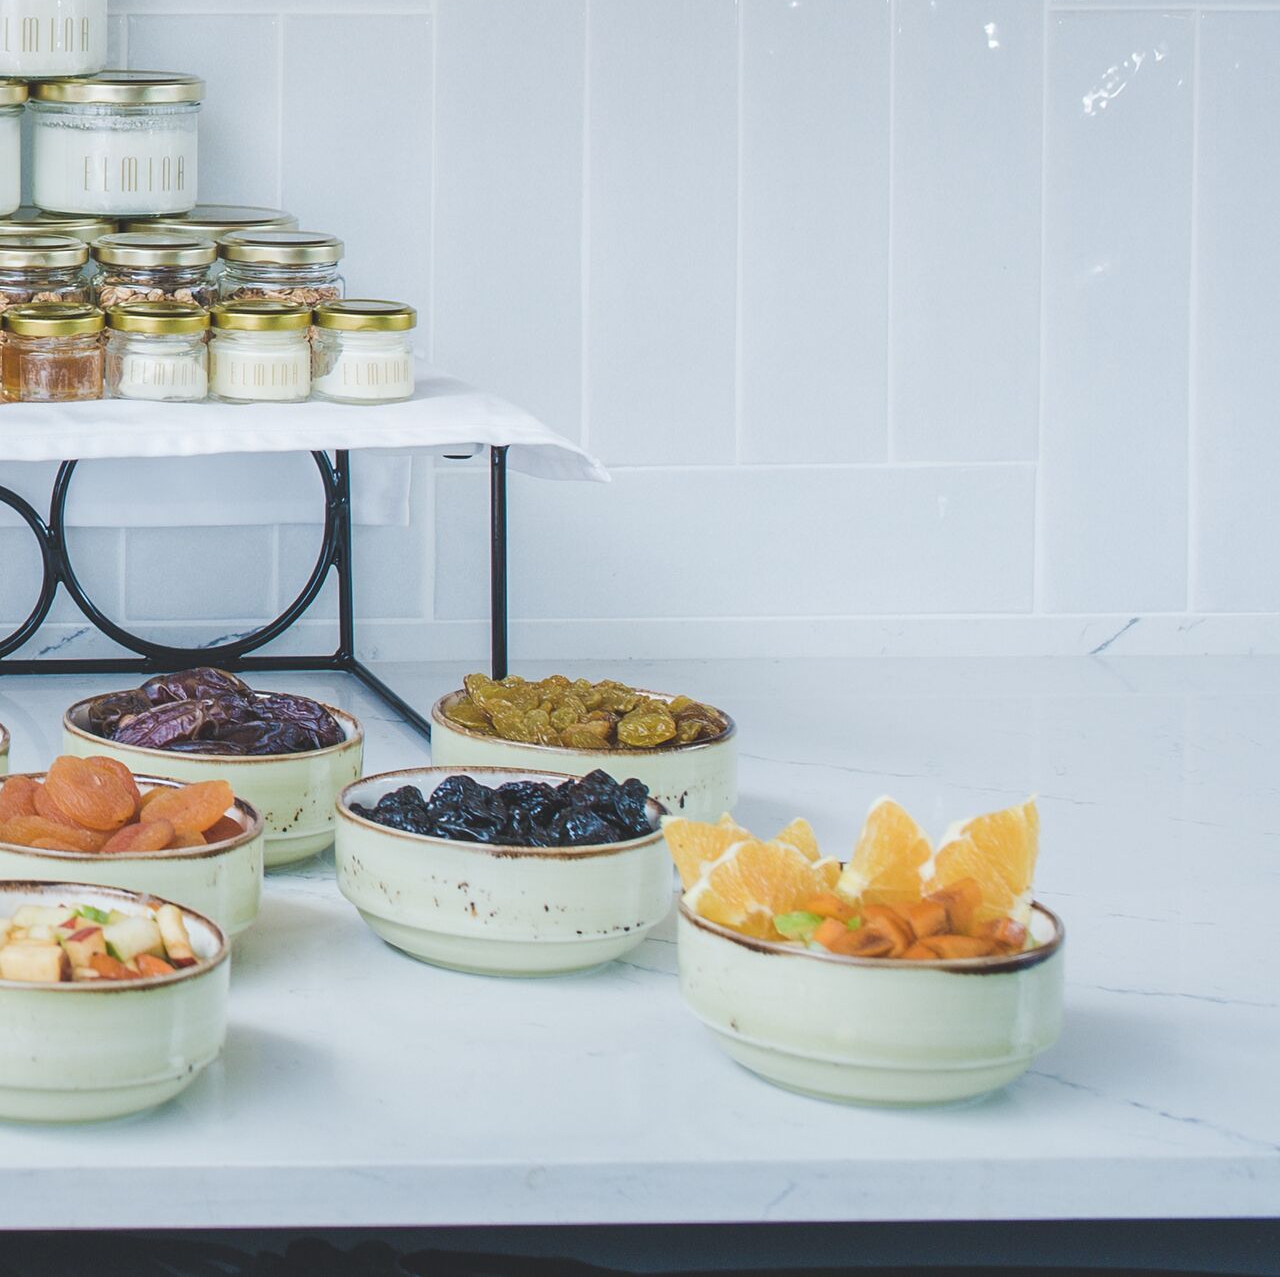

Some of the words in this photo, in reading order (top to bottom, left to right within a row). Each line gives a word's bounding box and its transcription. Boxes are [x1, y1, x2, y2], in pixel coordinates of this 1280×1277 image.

[84, 155, 185, 192] ELMINA
[230, 360, 299, 386] ELMINA
[343, 359, 410, 386] ELMINA
